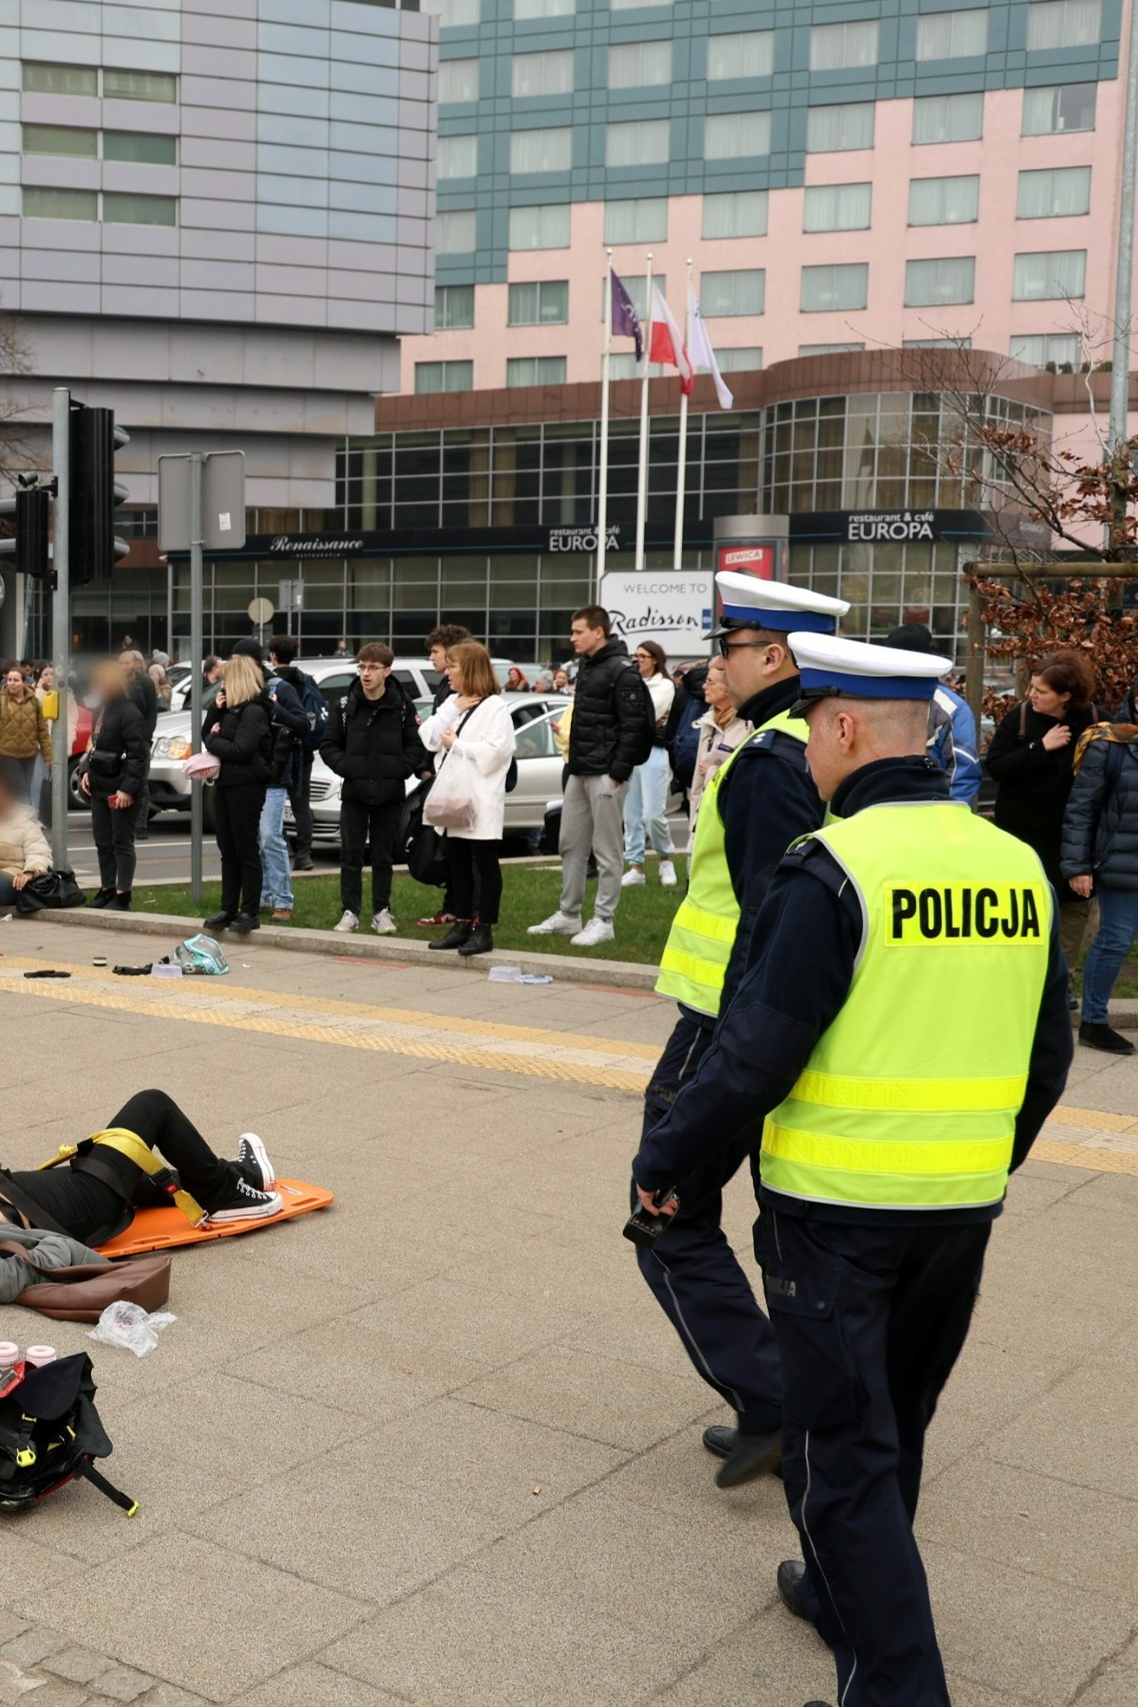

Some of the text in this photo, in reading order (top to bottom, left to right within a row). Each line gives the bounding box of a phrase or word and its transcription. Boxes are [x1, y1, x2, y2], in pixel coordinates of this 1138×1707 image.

[848, 513, 901, 522] restaurant
[903, 512, 912, 522] &
[549, 527, 592, 536] restaurant
[848, 522, 934, 540] EUROPA
[270, 535, 363, 551] Renaissance
[549, 535, 620, 551] EUROA
[623, 583, 708, 594] WELCOME TO
[608, 606, 699, 635] Radisson
[891, 888, 1040, 939] POLICJA
